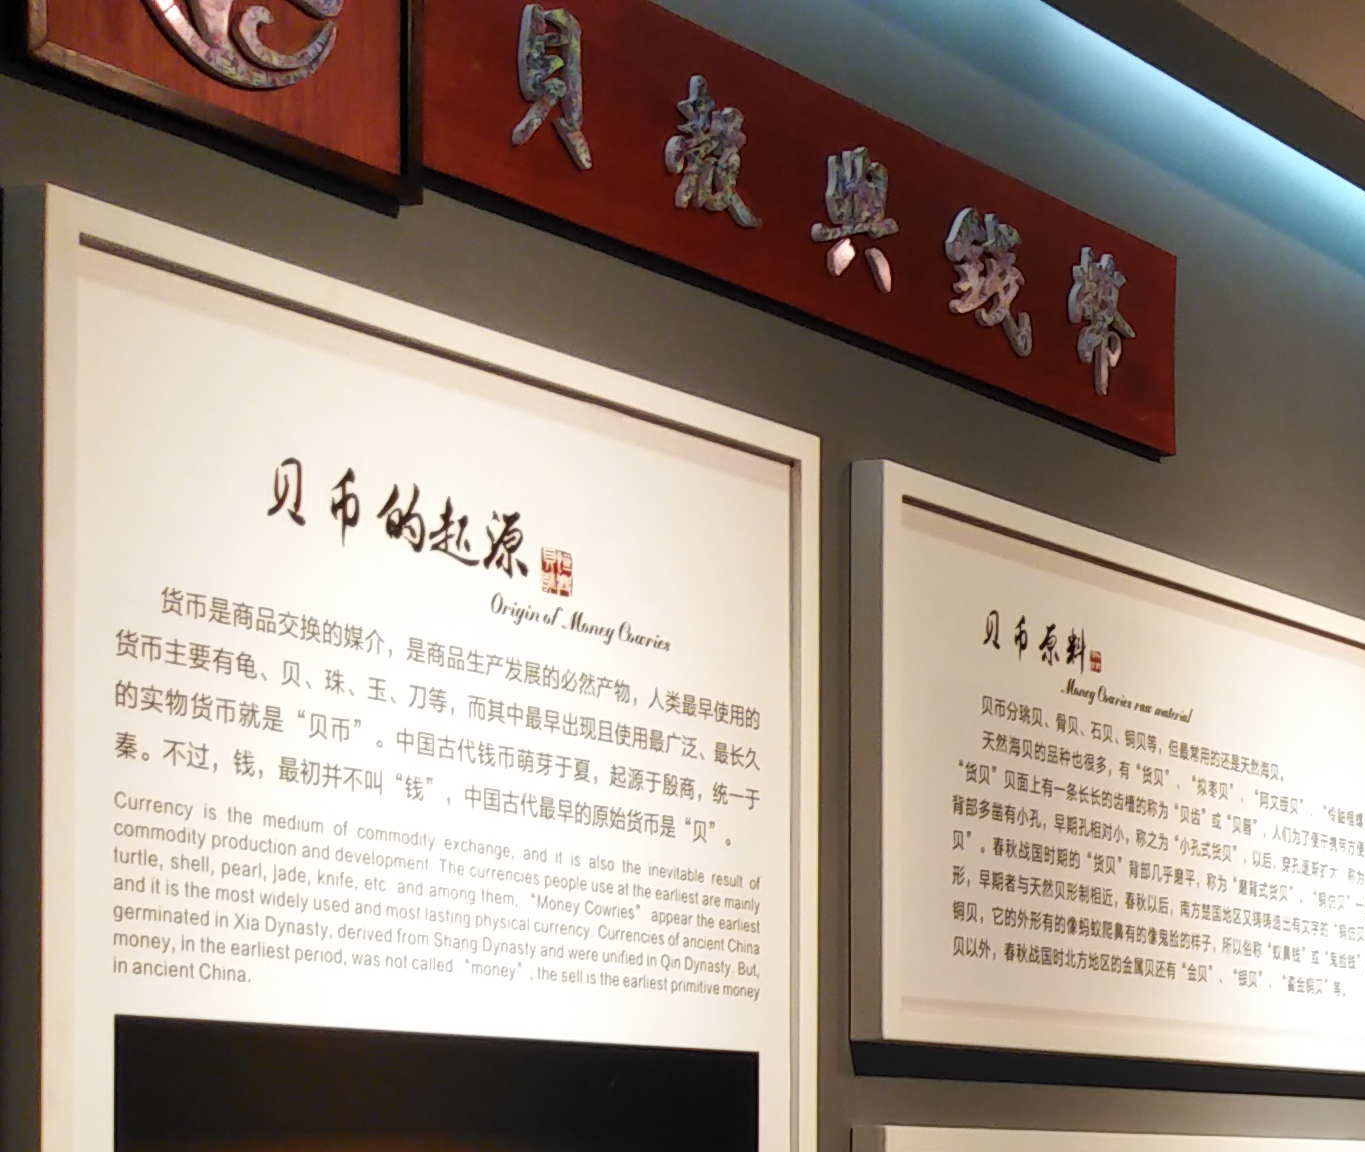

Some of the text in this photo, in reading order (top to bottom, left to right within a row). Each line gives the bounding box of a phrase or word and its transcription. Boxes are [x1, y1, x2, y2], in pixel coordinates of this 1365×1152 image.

[267, 457, 529, 579] 贝币的起源
[490, 592, 672, 652] Origin of Money Cowries
[983, 610, 1087, 674] 贝币原料
[113, 791, 761, 891] Currency is the medium of commodity exchange, and it is also the inevitable result of
[113, 822, 207, 849] commodity
[211, 834, 297, 856] production
[301, 844, 330, 861] and
[439, 858, 465, 877] The
[469, 866, 540, 886] currencies
[544, 875, 587, 892] people
[591, 881, 614, 895] use
[616, 882, 630, 896] at
[632, 883, 652, 899] the
[654, 888, 699, 905] earliest
[701, 894, 721, 908] are
[724, 897, 761, 915] mainly
[113, 846, 163, 871] turtle,
[170, 853, 214, 876] shell,
[221, 861, 267, 882] pearl,
[272, 864, 311, 886] jade,
[317, 869, 358, 890] knife,
[397, 881, 423, 896] and
[429, 885, 476, 905] among
[481, 889, 518, 908] them,
[651, 910, 693, 926] appear
[696, 913, 715, 929] the
[718, 918, 760, 934] earliest
[113, 876, 146, 893] and
[150, 877, 160, 895] it
[165, 879, 180, 897] is
[184, 881, 211, 900] the
[215, 887, 255, 904] most
[259, 891, 309, 913] widely
[313, 898, 350, 914] used
[354, 902, 382, 917] and
[385, 905, 421, 920] most
[425, 907, 471, 929] lasting
[475, 913, 530, 932] physical
[597, 924, 665, 946] Currencies
[667, 931, 681, 947] of
[682, 936, 725, 951] ancient
[727, 937, 760, 956] China
[112, 956, 251, 983] in ancient China.
[113, 905, 210, 927] germinated
[214, 911, 229, 928] in
[233, 912, 260, 931] Xia
[265, 915, 332, 940] Dynasty,
[337, 923, 393, 943] derived
[396, 927, 429, 946] from
[433, 931, 478, 954] Shang
[482, 936, 537, 959] Dynasty
[540, 944, 565, 959] and
[567, 949, 599, 963] were
[602, 949, 644, 967] unified
[646, 954, 658, 967] in
[660, 953, 681, 972] Qin
[737, 960, 760, 979] But,
[113, 932, 176, 954] money,
[180, 934, 195, 953] in
[200, 936, 226, 955] the
[230, 941, 290, 960] earliest
[294, 948, 347, 966] period,
[351, 953, 381, 967] was
[385, 955, 408, 969] not
[411, 957, 454, 973] called
[537, 966, 558, 982] the
[561, 969, 583, 984] sell
[586, 973, 597, 985] is
[599, 971, 620, 988] the
[622, 975, 668, 991] earliest
[670, 980, 720, 995] primitive
[722, 984, 760, 1002] money
